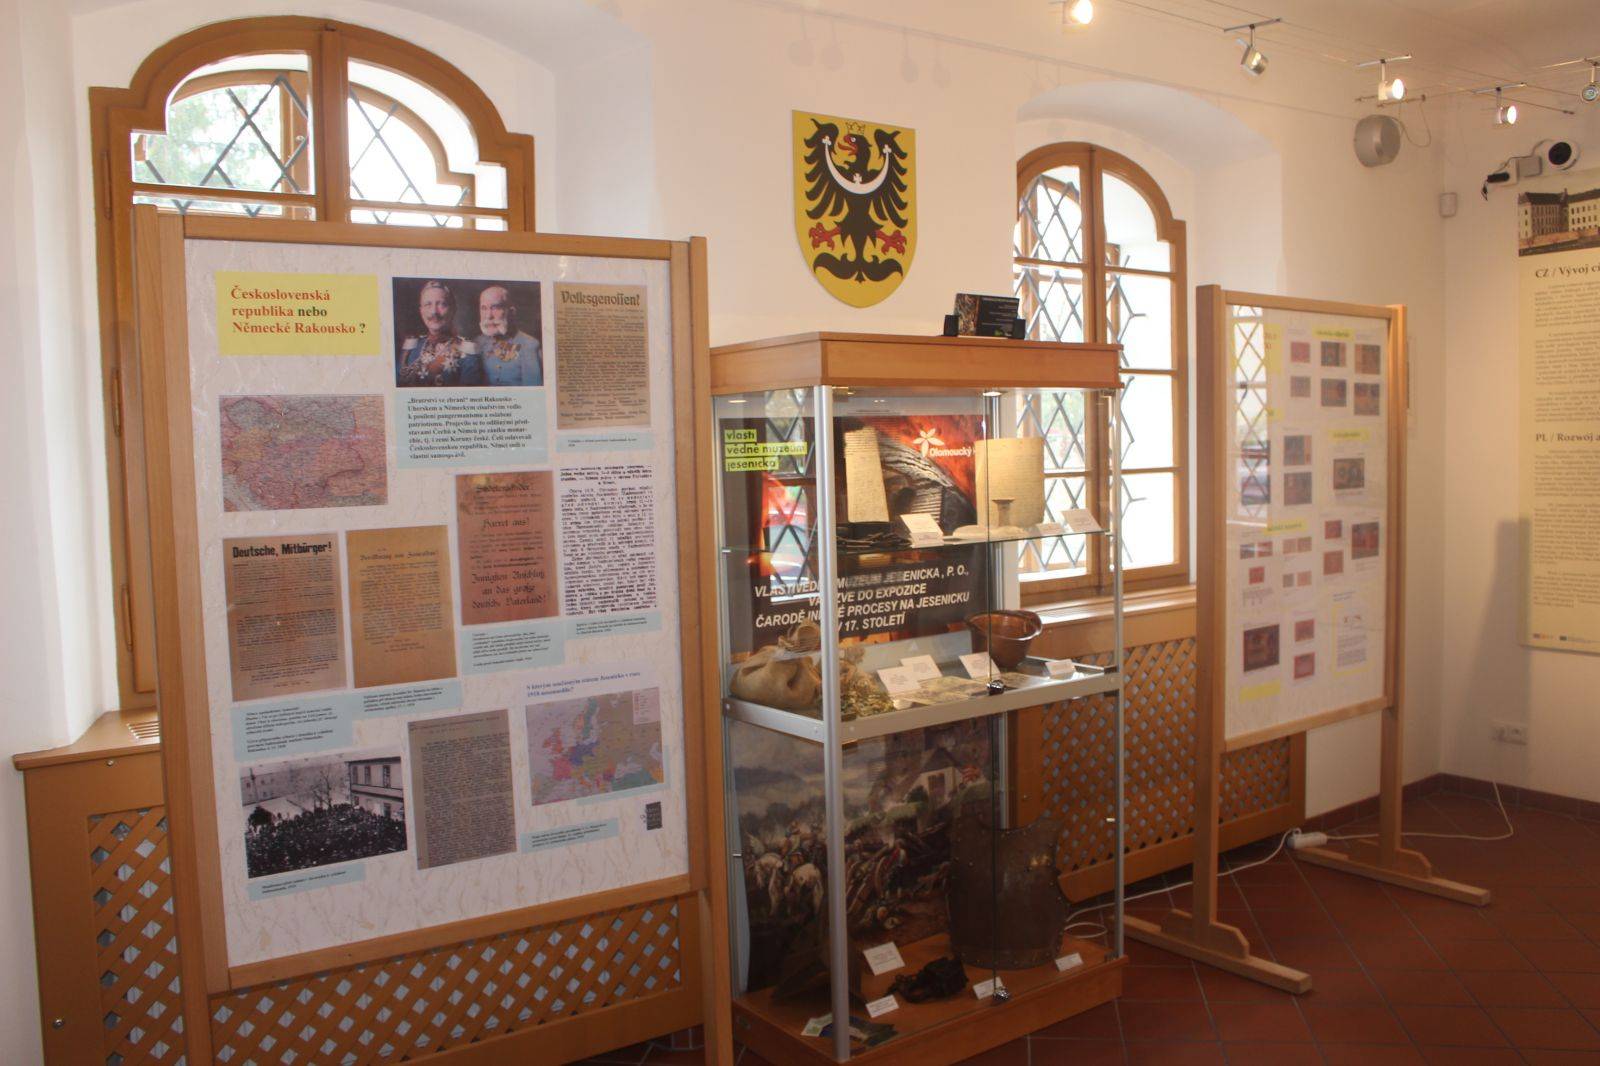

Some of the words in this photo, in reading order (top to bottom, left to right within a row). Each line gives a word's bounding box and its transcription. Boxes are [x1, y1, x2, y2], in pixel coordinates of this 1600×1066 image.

[1535, 268, 1549, 279] CZ
[230, 285, 331, 301] Československá
[232, 305, 294, 319] republika
[297, 305, 328, 317] nebo
[232, 321, 291, 334] Německé
[294, 322, 356, 334] Rakousko
[359, 323, 366, 334] ?
[1535, 432, 1547, 442] PL
[929, 446, 973, 457] Olomoucký
[728, 456, 776, 471] jesenicka
[232, 545, 279, 558] Deutsche,
[281, 541, 332, 555] Mitbürger!
[947, 565, 955, 577] P.
[857, 589, 874, 601] DO
[875, 583, 927, 599] EXPOZICE
[847, 600, 899, 617] PROCESY
[899, 599, 915, 610] NA
[916, 591, 970, 608] JESENICKU
[844, 619, 859, 632] 17.
[862, 612, 906, 629] STOLETÍ
